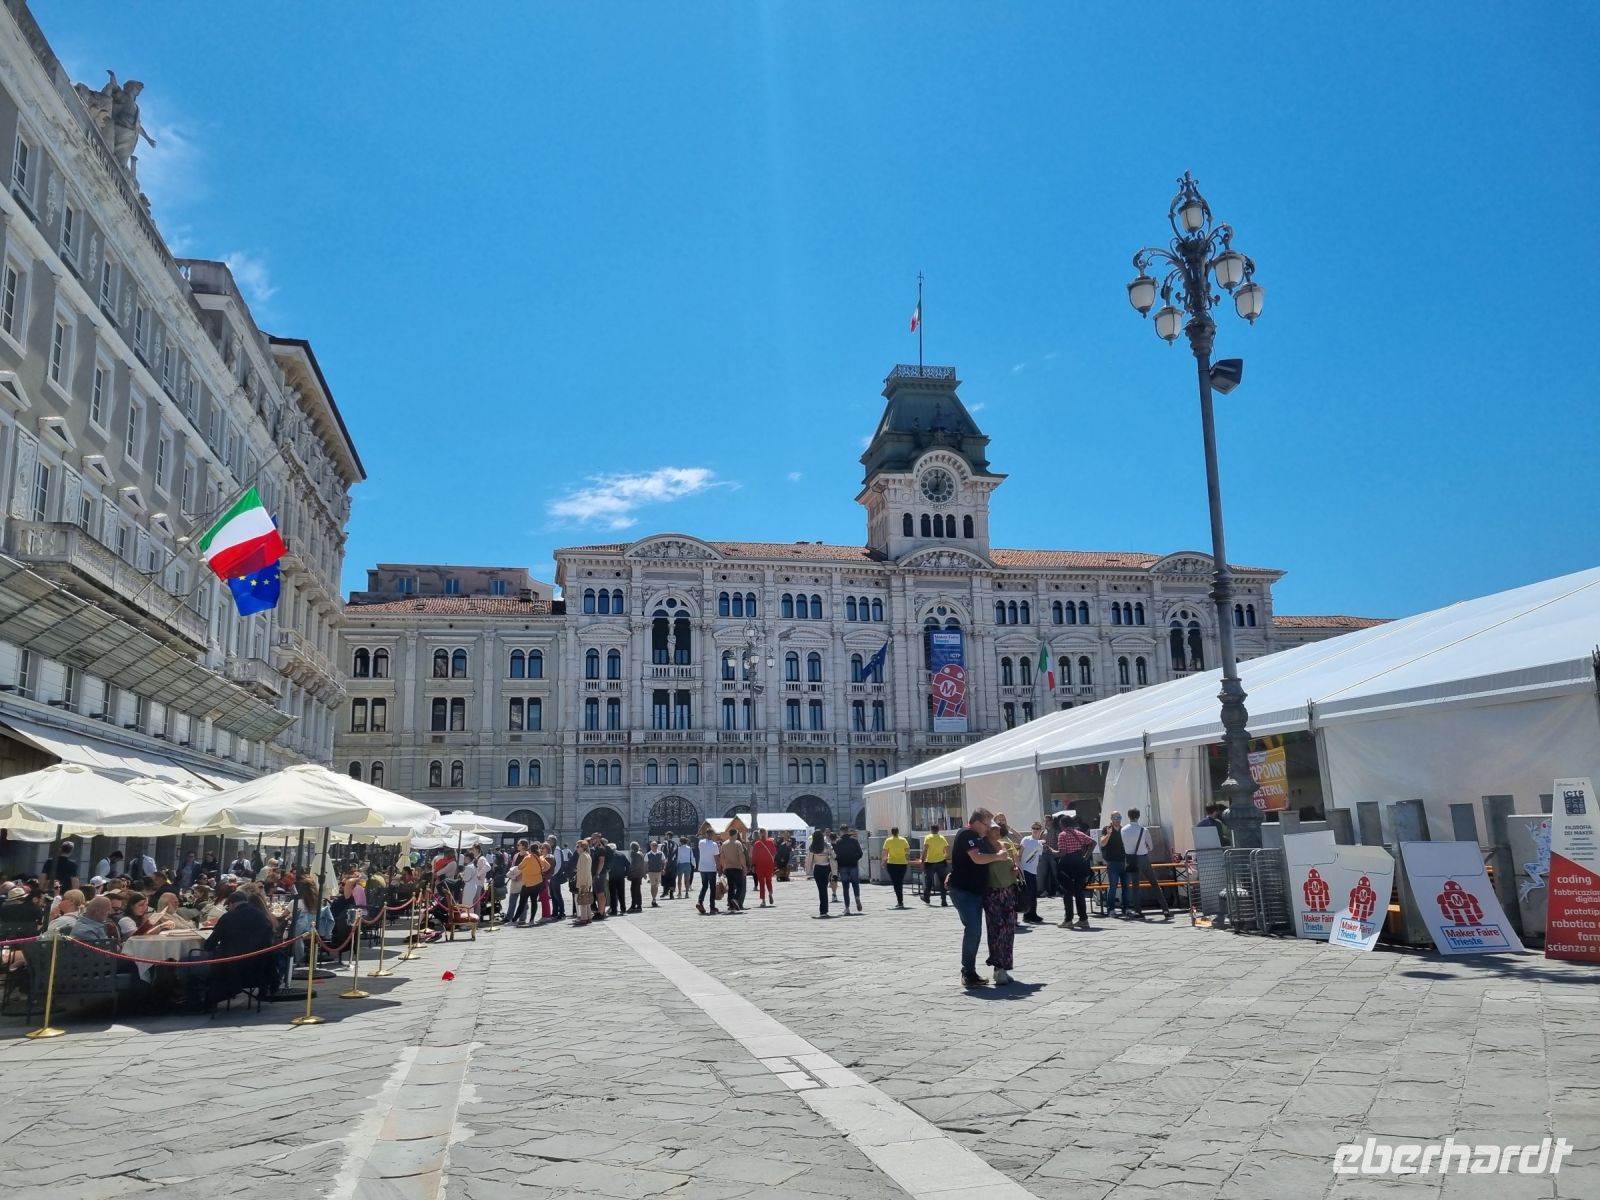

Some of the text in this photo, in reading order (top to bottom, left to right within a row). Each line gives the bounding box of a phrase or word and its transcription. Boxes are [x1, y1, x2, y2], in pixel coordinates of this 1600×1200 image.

[941, 682, 955, 696] M
[1250, 762, 1286, 781] OPOINT
[1557, 875, 1592, 886] coding
[1313, 882, 1319, 891] M
[1361, 891, 1367, 900] M
[1452, 896, 1463, 905] M
[1303, 914, 1334, 923] Maker Fair
[1305, 923, 1324, 931] Trieste
[1341, 920, 1372, 934] Maker Faire
[1552, 919, 1596, 929] robotica
[1341, 930, 1357, 940] Trieste
[1445, 928, 1500, 938] Maker Faire
[1450, 937, 1484, 946] Trieste
[1548, 943, 1587, 952] scienza
